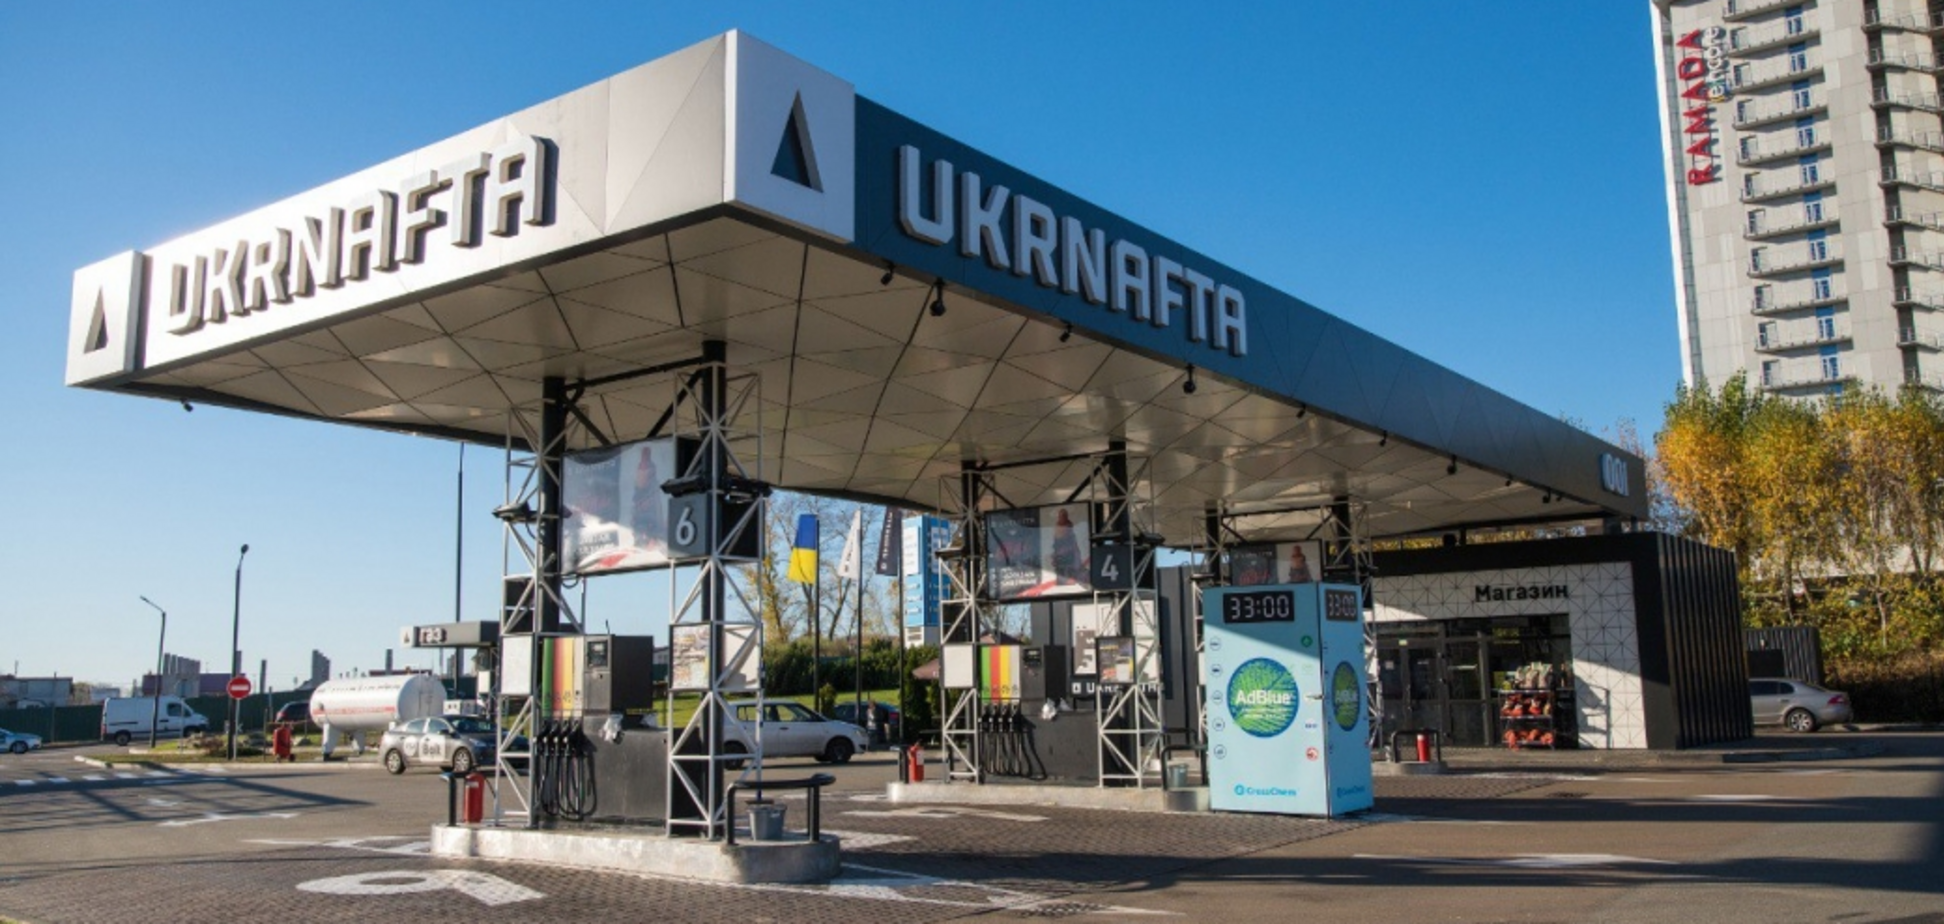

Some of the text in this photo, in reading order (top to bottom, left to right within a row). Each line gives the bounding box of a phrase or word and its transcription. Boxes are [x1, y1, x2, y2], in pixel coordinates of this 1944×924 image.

[1701, 27, 1726, 98] encore
[1676, 29, 1714, 186] RAMADA
[167, 134, 548, 335] UKRNAFTA
[900, 144, 1248, 357] UKRNAFTA
[676, 507, 697, 545] 6
[1101, 554, 1119, 581] 4
[1231, 595, 1290, 620] 33:00
[1474, 584, 1569, 601] Магазин
[1235, 689, 1290, 705] AdBlue
